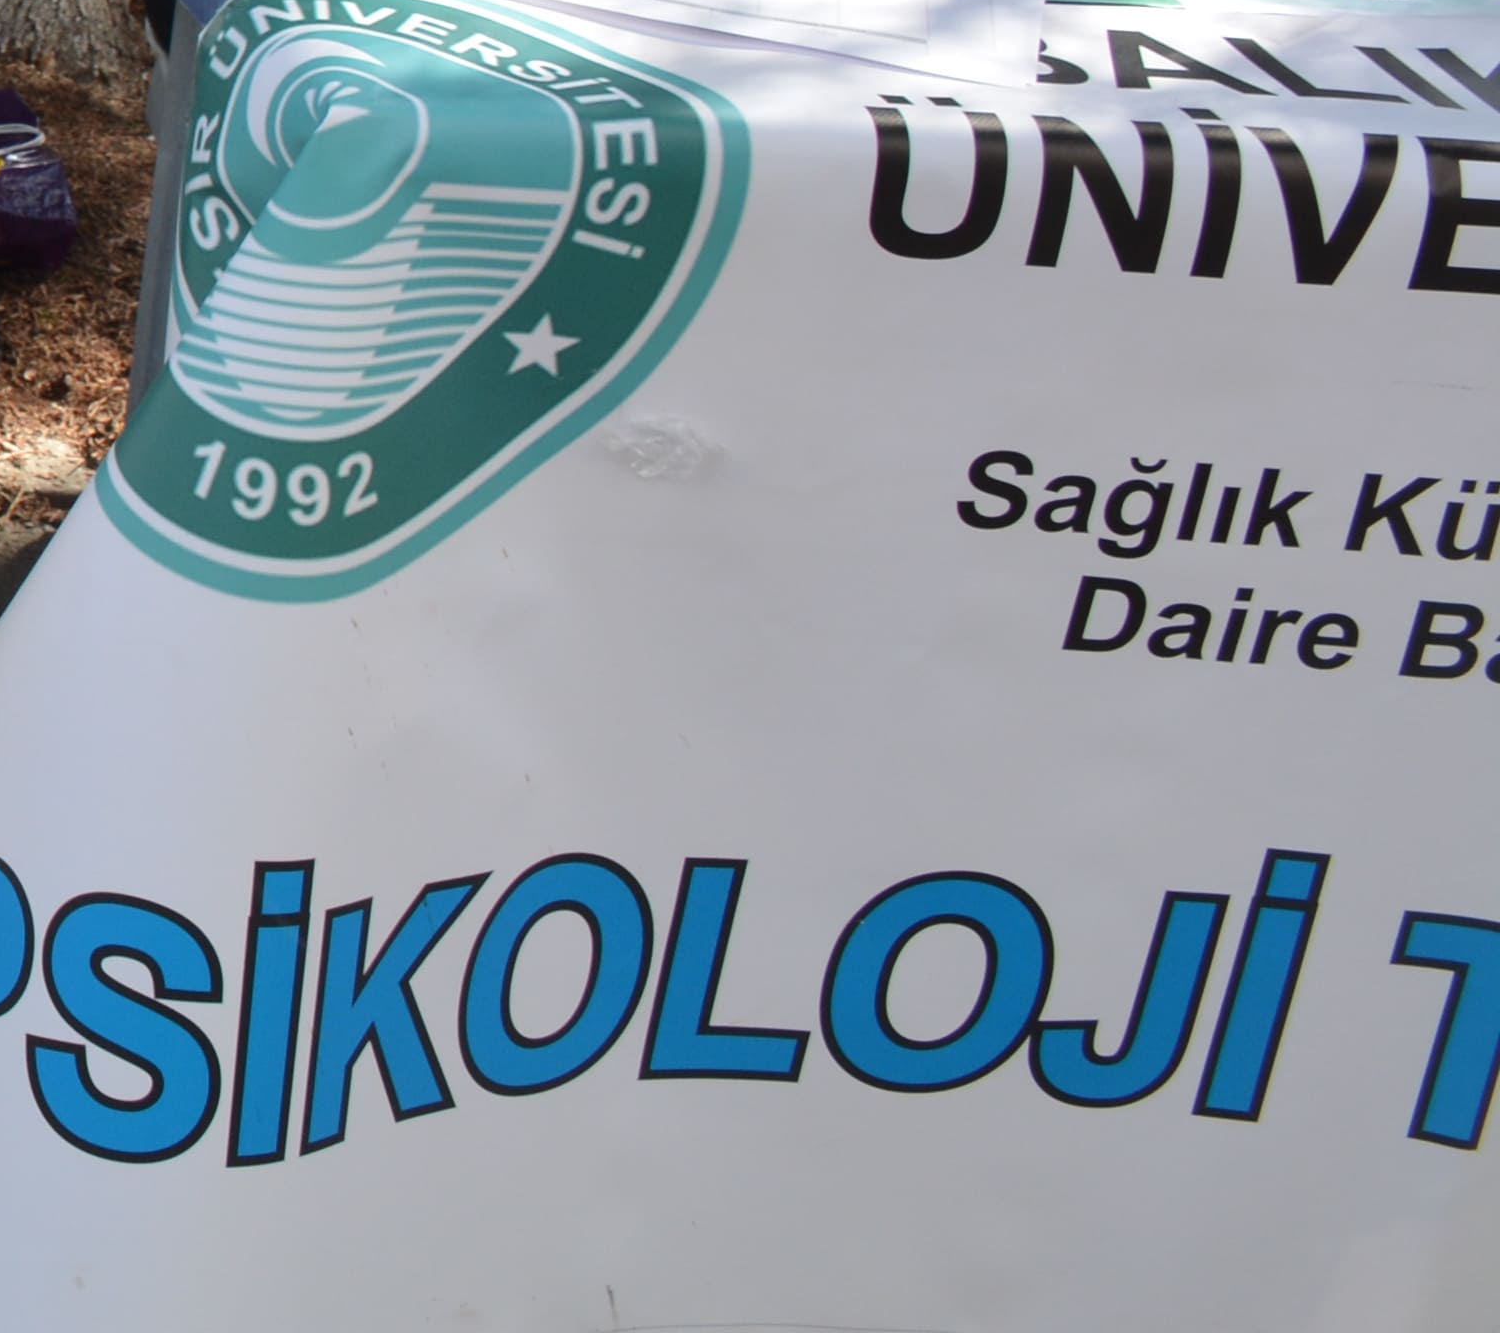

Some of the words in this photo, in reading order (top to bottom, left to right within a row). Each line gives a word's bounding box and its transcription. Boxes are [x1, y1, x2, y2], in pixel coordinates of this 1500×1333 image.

[190, 437, 379, 527] 1992
[956, 450, 1314, 559] Sağlık
[1062, 575, 1360, 670] Daire
